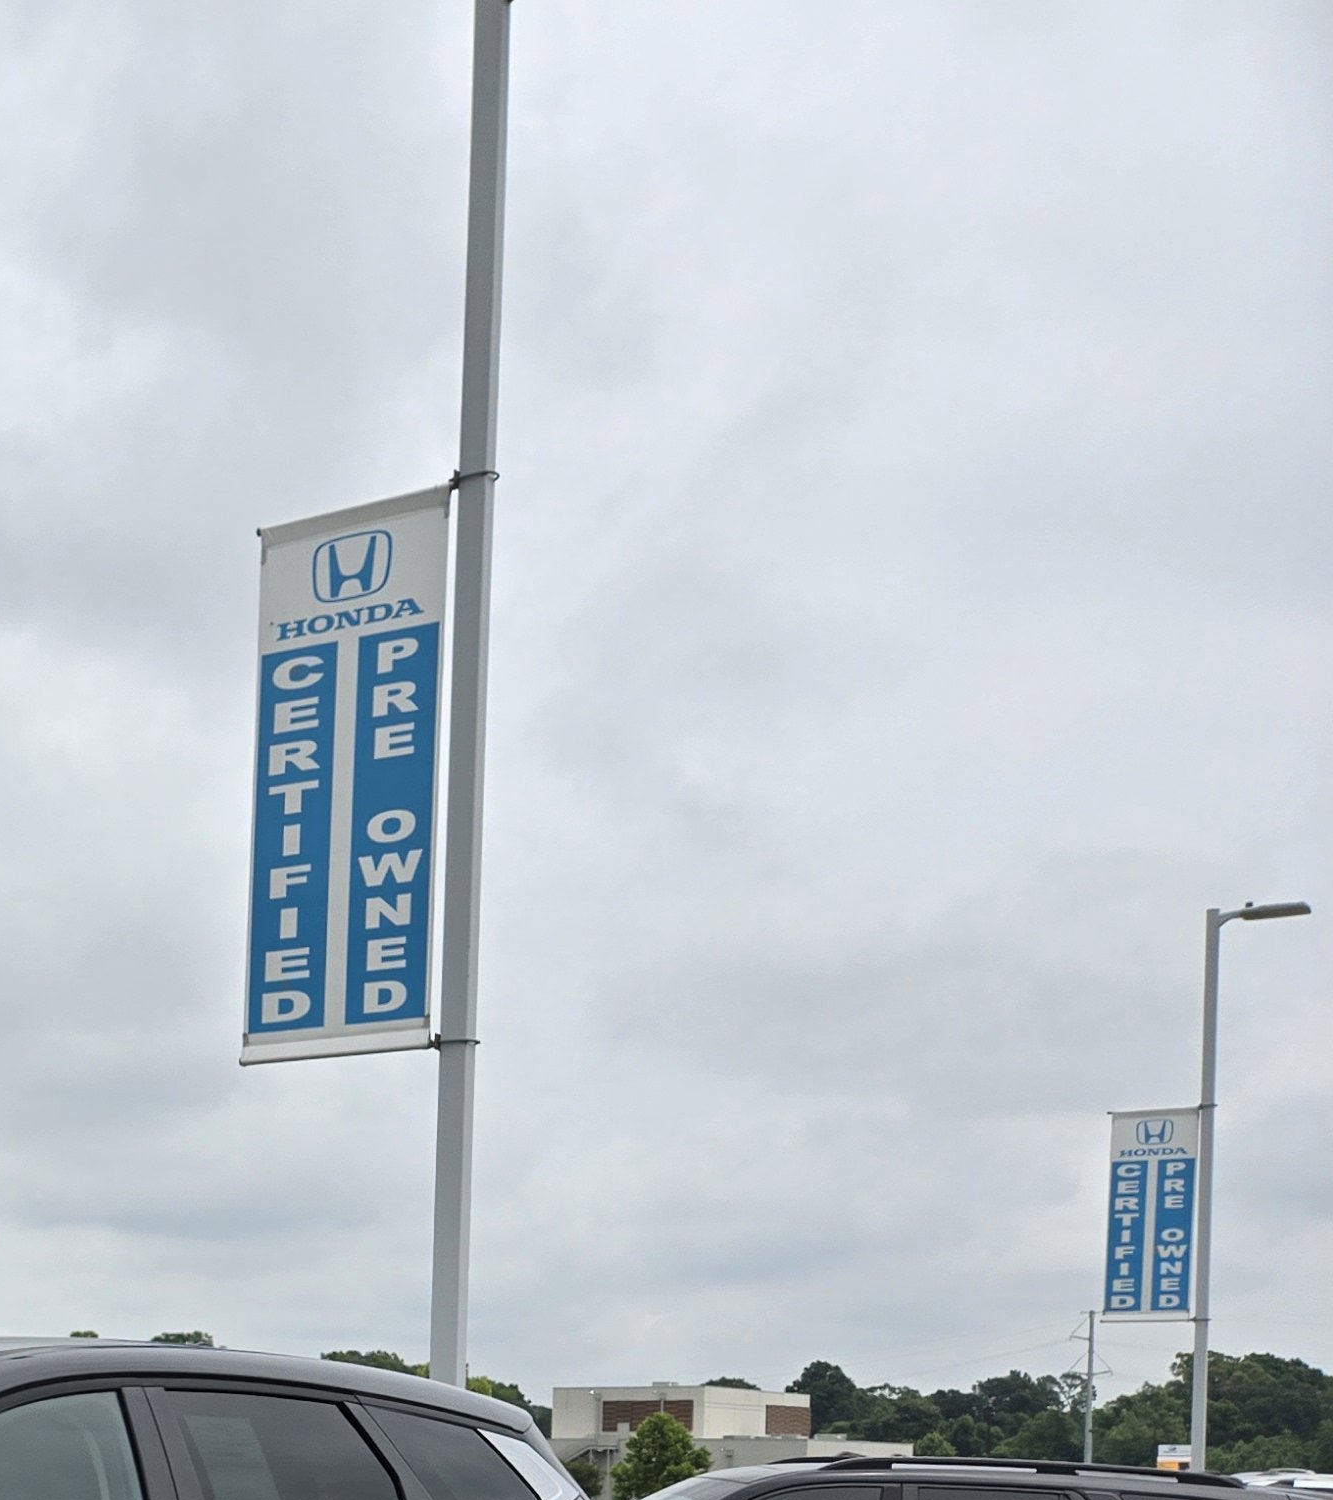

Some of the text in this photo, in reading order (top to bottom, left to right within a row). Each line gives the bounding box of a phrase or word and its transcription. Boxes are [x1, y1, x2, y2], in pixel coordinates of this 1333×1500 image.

[276, 598, 424, 641] HONDA
[261, 655, 324, 1025] CERTIFIED
[357, 637, 424, 1015] PRE OWNED
[1119, 1147, 1188, 1157] HONDA
[1110, 1164, 1142, 1309] CERTIFIED
[1156, 1162, 1187, 1308] PRE OWNED
